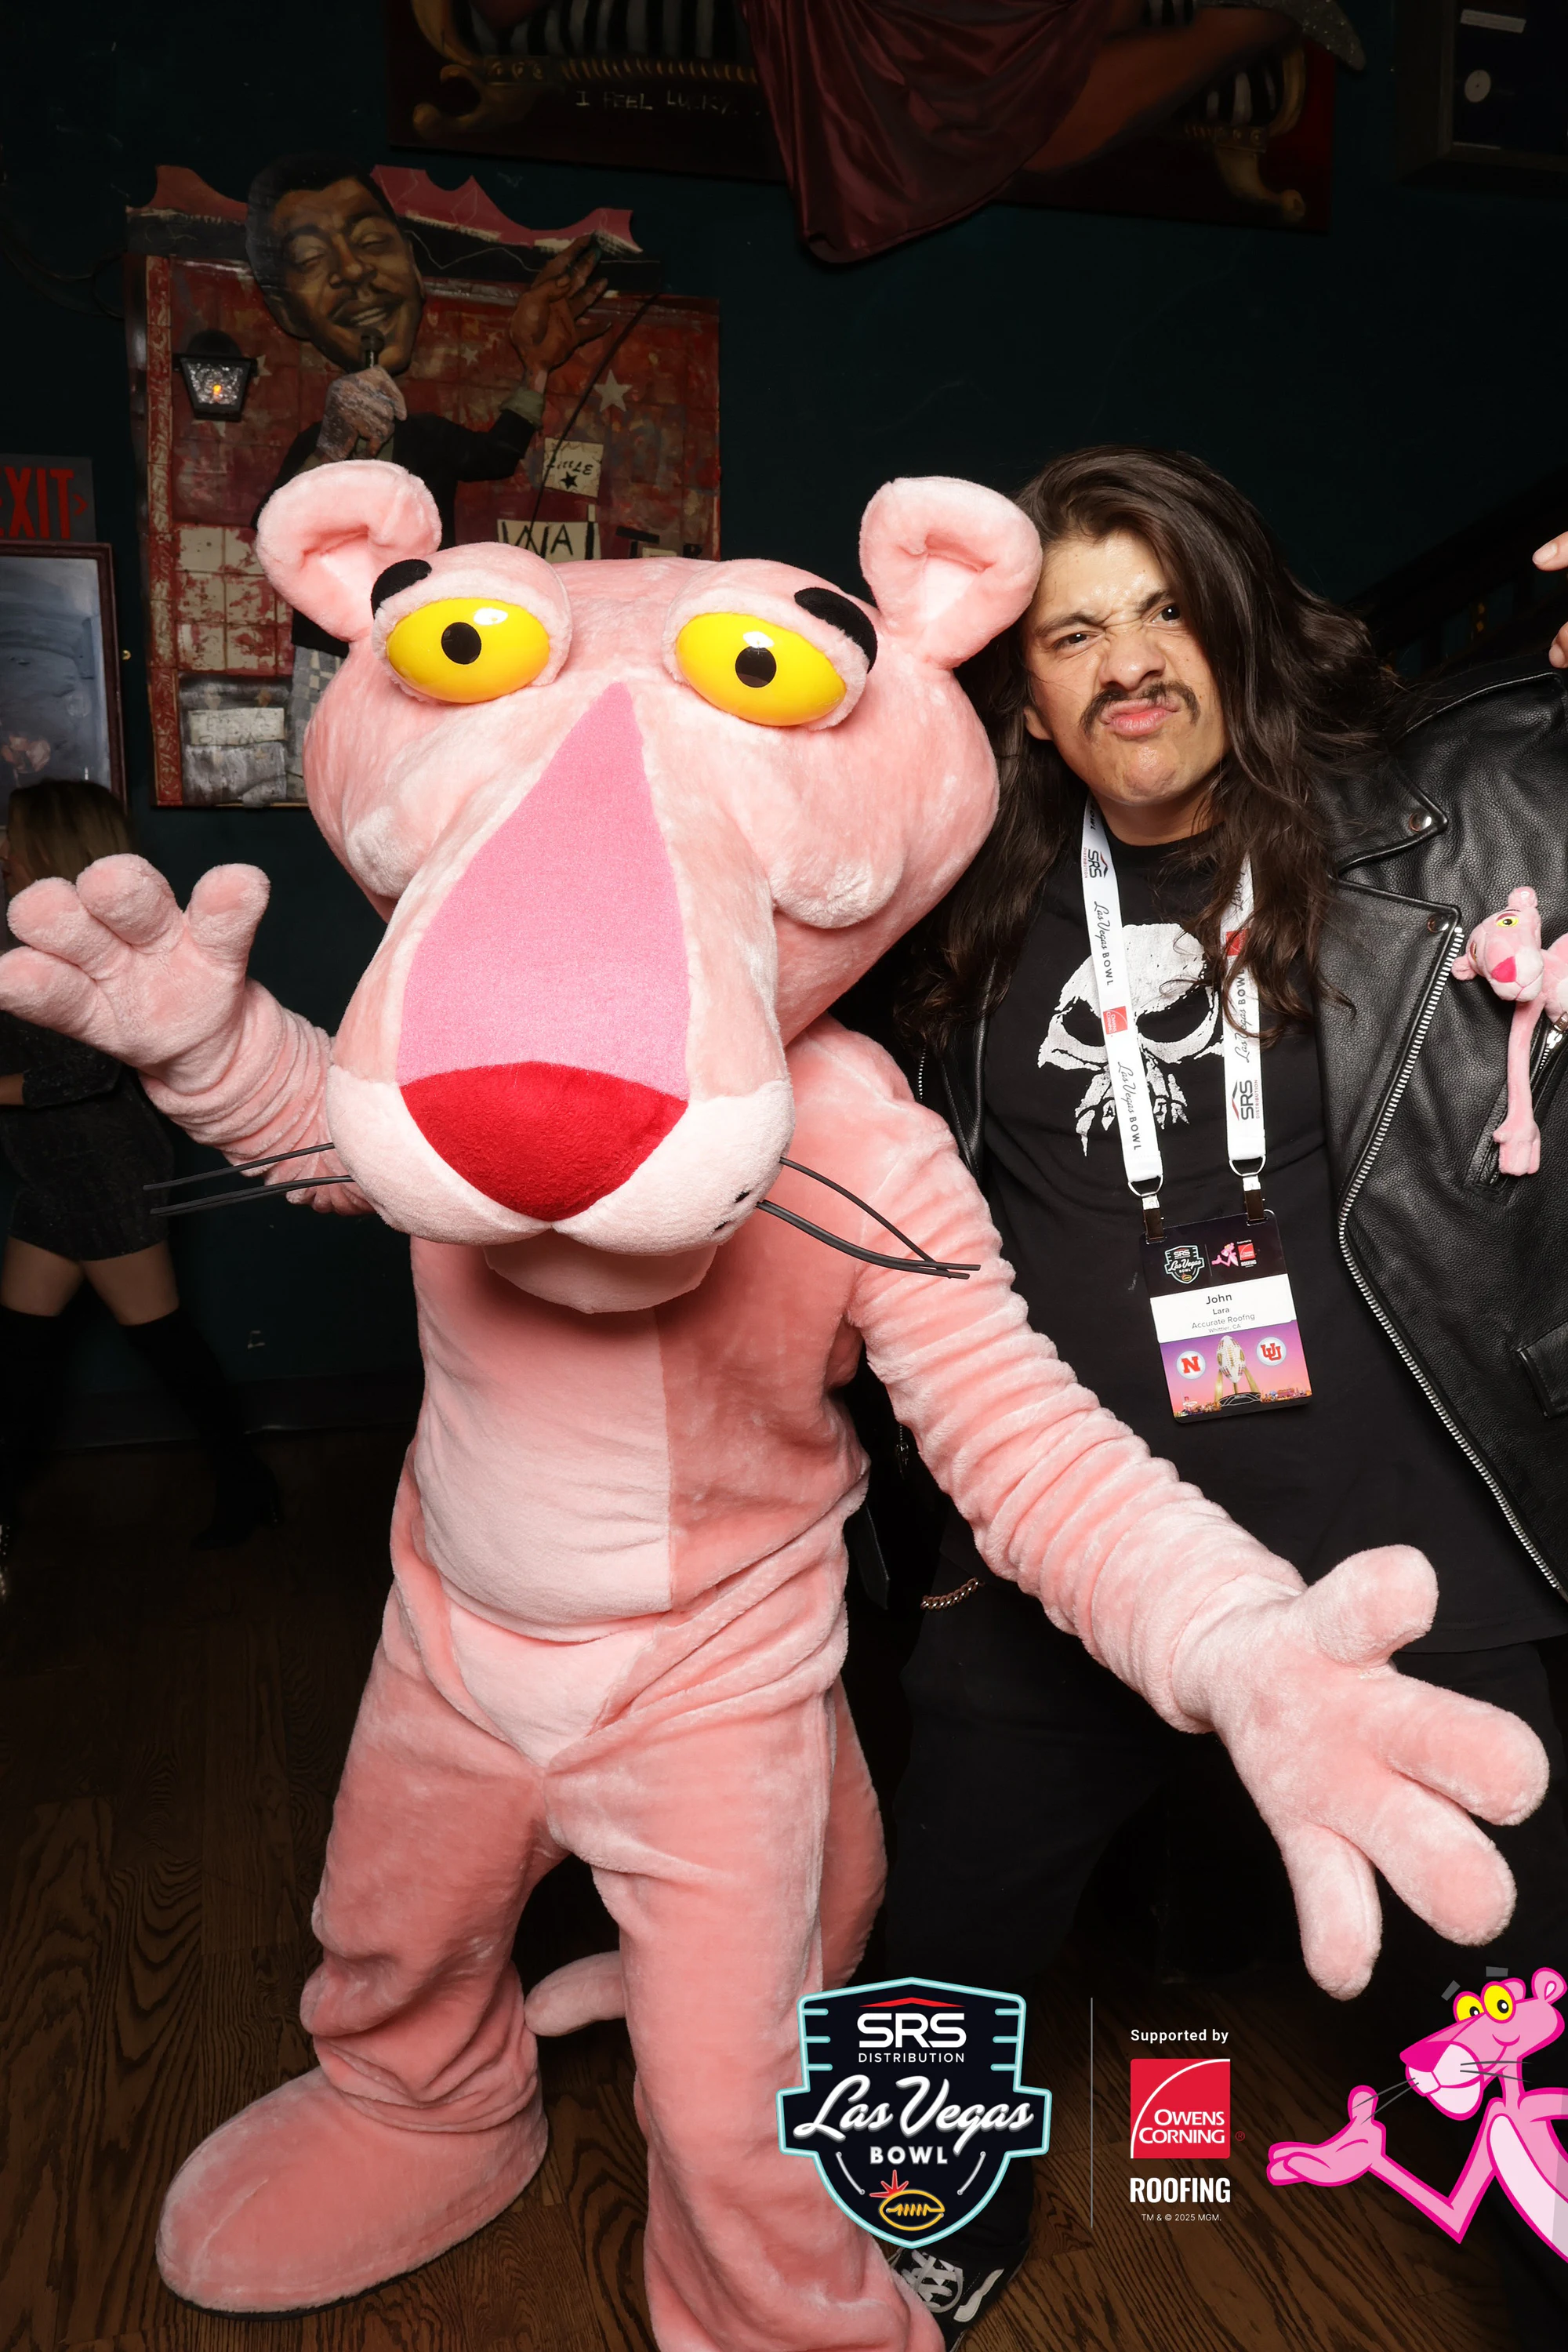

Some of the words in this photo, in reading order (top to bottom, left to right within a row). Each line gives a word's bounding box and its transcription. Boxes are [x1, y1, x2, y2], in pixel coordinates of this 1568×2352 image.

[576, 90, 590, 106] I
[603, 91, 653, 111] FEEL
[0, 466, 74, 539] XIT
[1088, 848, 1102, 878] SRS
[1094, 901, 1109, 921] Las
[1094, 920, 1111, 950] Vegas
[1102, 952, 1114, 986] BOWL
[1234, 1040, 1250, 1064] Las
[1117, 1062, 1134, 1083] Las
[1120, 1082, 1137, 1114] Vegas
[1240, 1080, 1254, 1120] SRS
[1129, 1116, 1142, 1151] BOWL
[1206, 1294, 1232, 1305] John
[1192, 1318, 1225, 1330] Accurate
[1181, 1356, 1201, 1374] N
